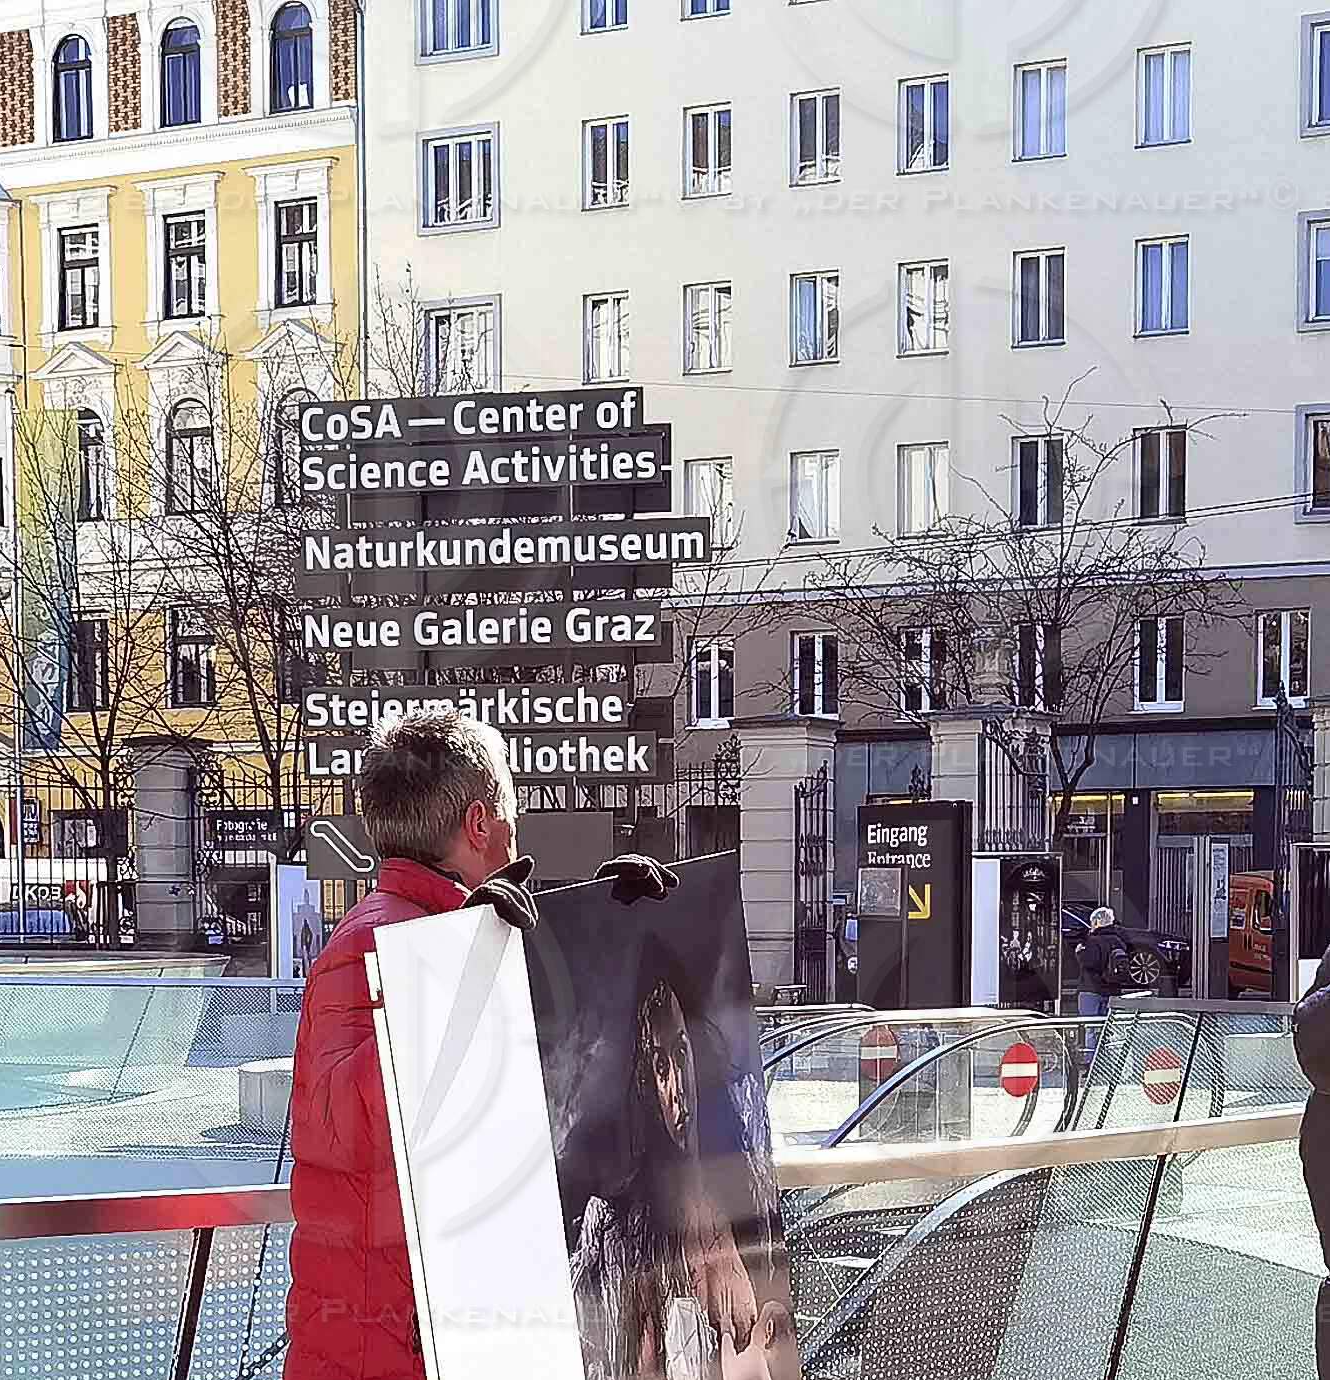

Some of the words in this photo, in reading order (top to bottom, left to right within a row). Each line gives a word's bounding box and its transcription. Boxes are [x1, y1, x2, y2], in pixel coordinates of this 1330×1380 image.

[301, 405, 402, 442] CoSA
[454, 398, 582, 435] Center
[596, 390, 637, 429] of
[303, 453, 450, 491] Science
[462, 443, 656, 486] Activities
[304, 529, 704, 570] Naturkundemuseum
[304, 613, 400, 649] Neue
[414, 608, 552, 648] Galerie
[565, 607, 655, 643] Graz
[308, 736, 652, 776] Laliothek
[867, 823, 929, 848] Eingang
[867, 851, 931, 869] Entrance
